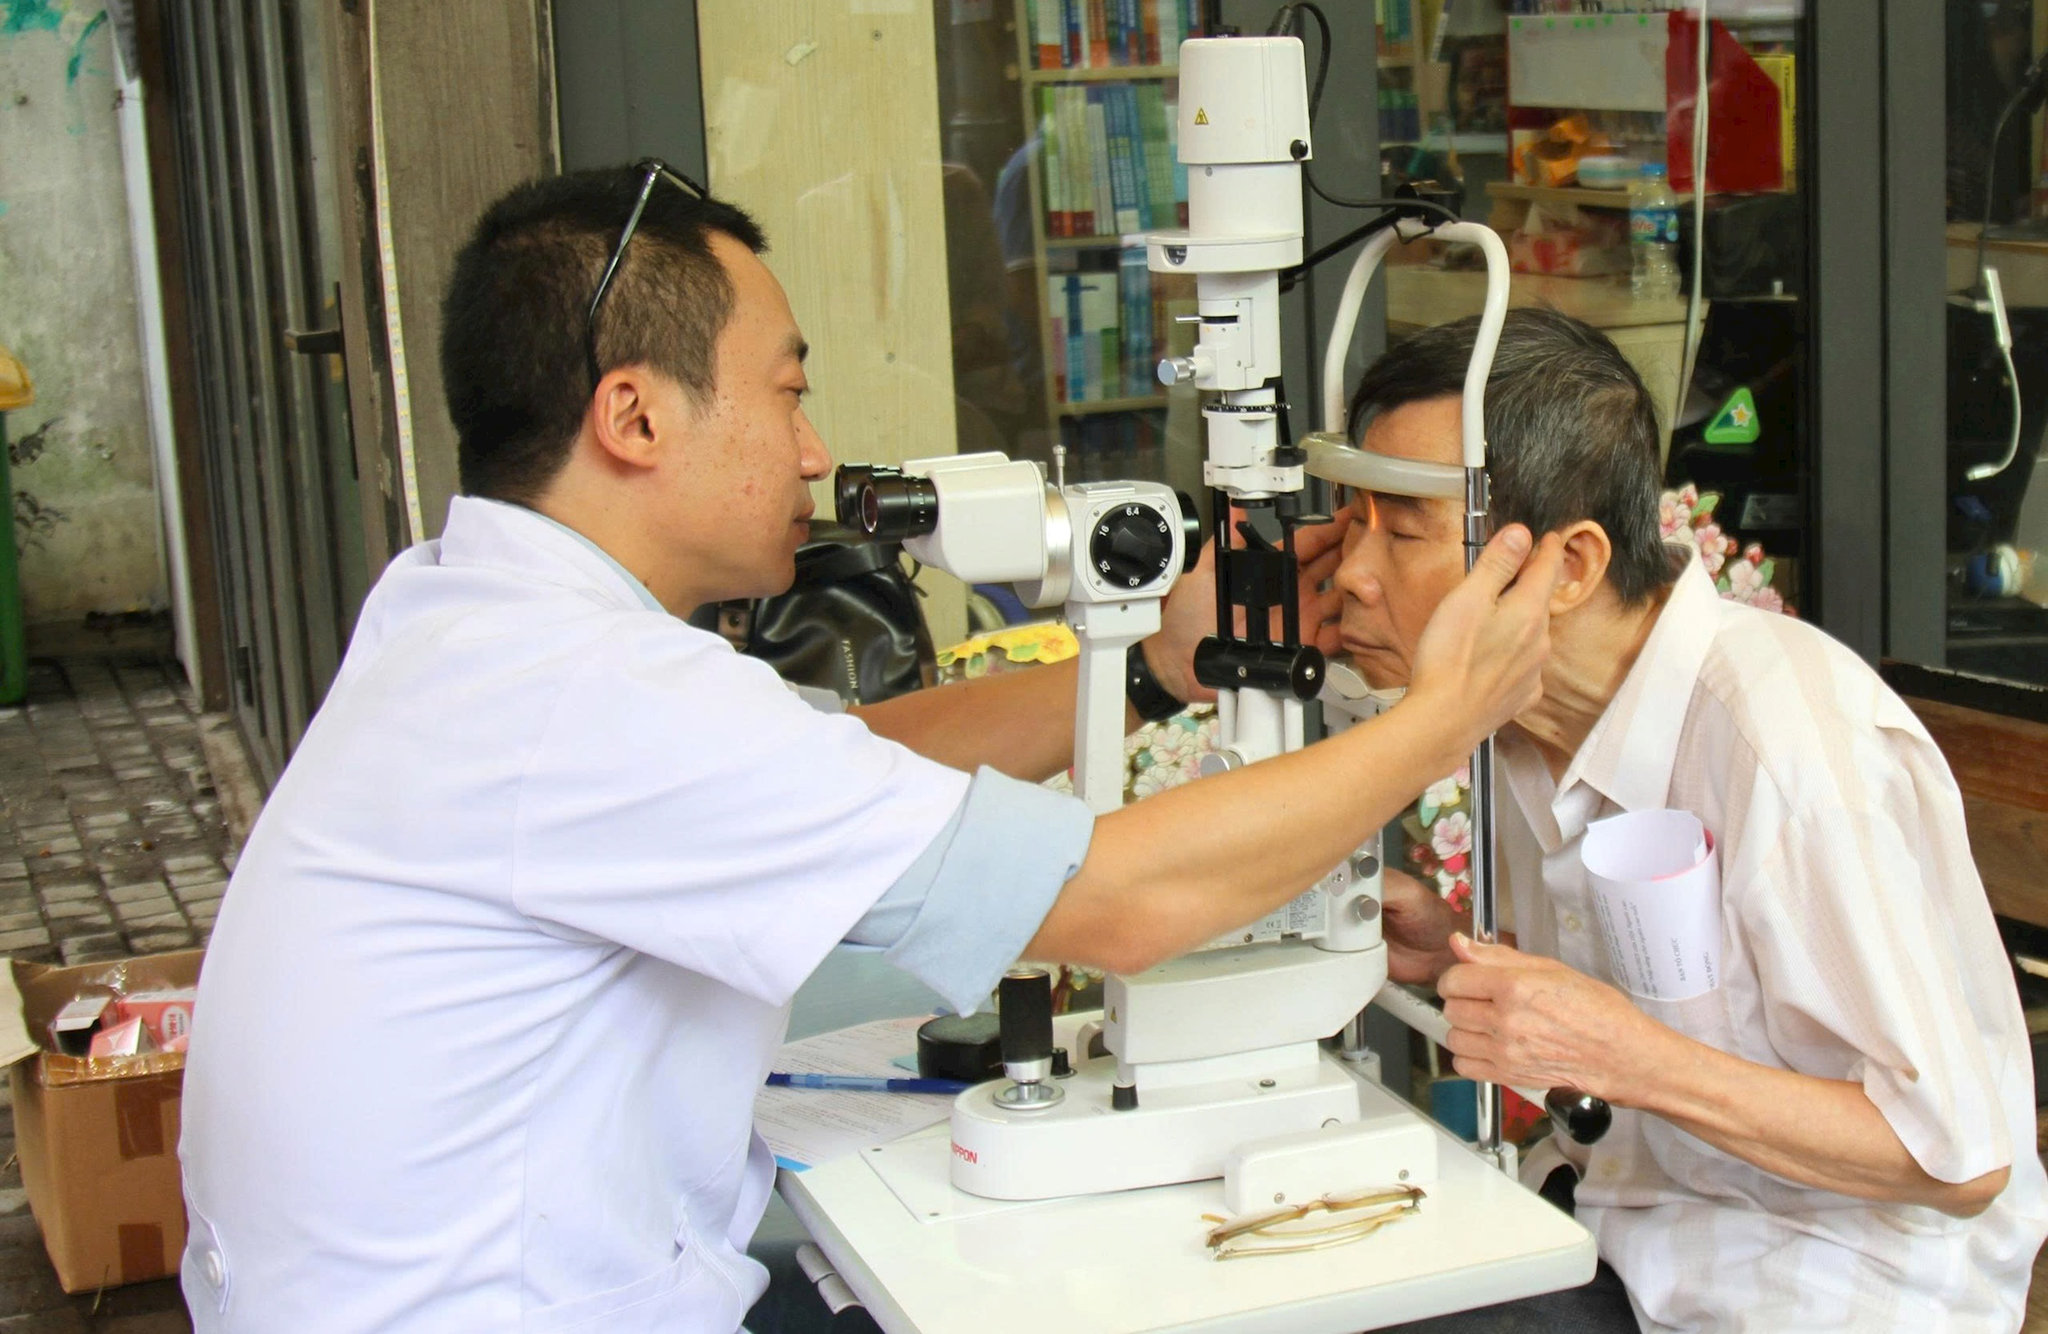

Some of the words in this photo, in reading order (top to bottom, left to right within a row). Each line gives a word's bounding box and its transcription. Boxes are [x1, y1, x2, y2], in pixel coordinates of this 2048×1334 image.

[1126, 507, 1140, 516] 6.4
[1157, 521, 1168, 533] 10
[1099, 560, 1111, 573] 25
[1128, 577, 1140, 586] 40
[841, 639, 858, 689] FASHION
